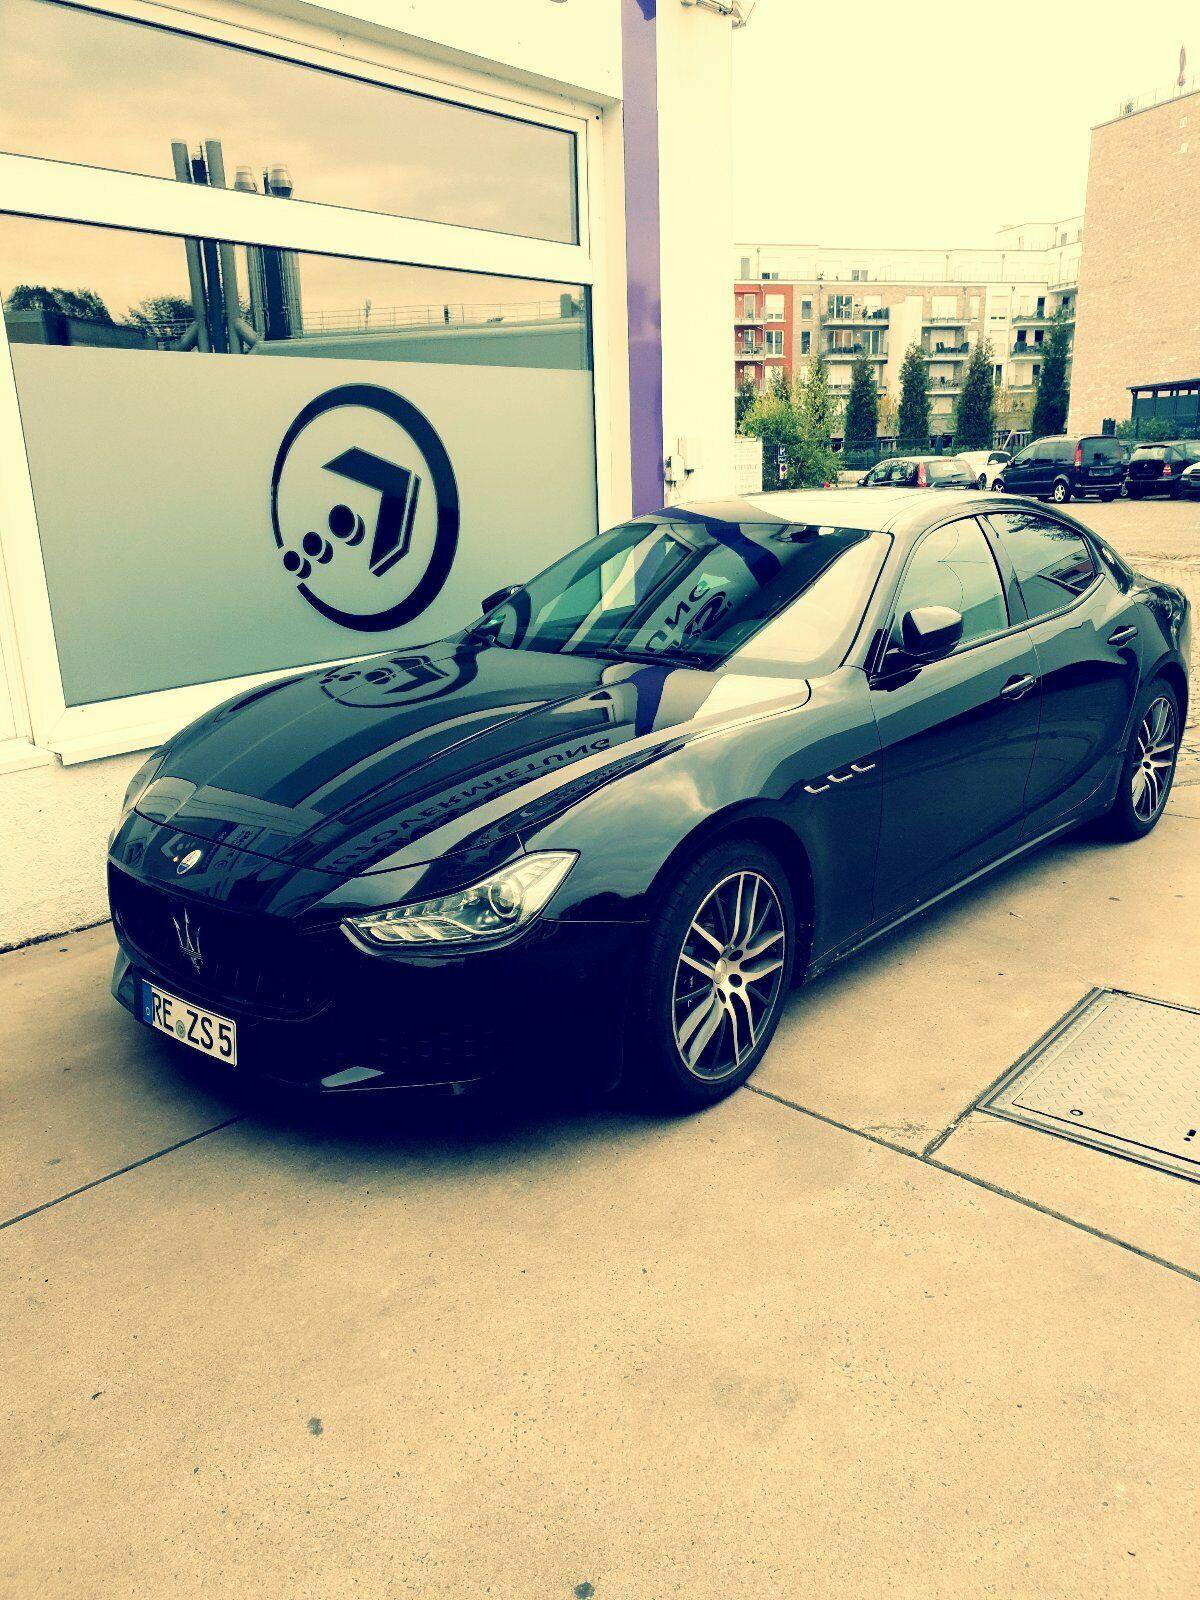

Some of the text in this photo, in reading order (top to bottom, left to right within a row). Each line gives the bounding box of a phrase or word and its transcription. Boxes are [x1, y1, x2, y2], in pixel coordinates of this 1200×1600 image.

[153, 992, 232, 1057] RE ZS 5
